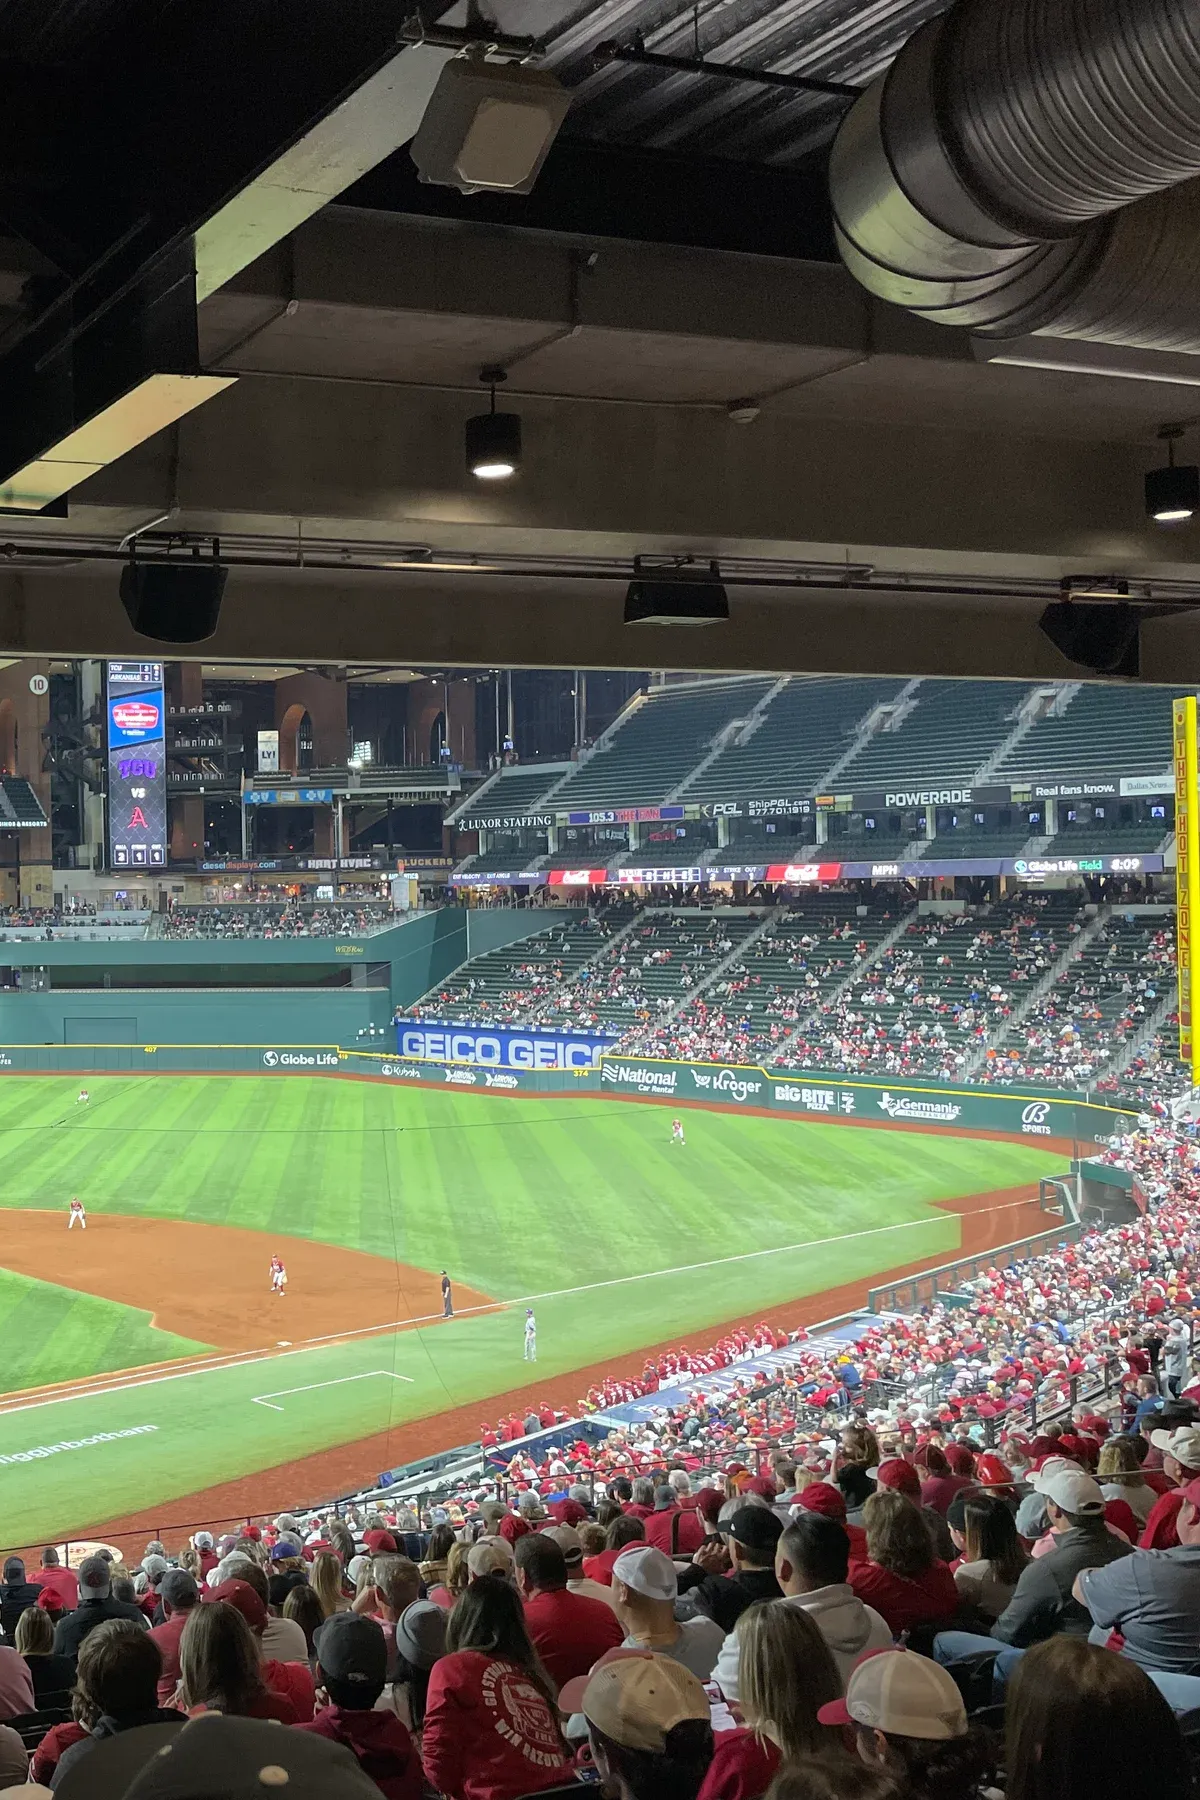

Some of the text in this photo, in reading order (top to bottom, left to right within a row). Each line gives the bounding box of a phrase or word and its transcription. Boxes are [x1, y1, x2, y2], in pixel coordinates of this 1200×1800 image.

[33, 679, 45, 690] 10
[118, 759, 157, 779] TCU
[131, 787, 146, 798] VS
[1035, 783, 1116, 797] Real fans know.
[713, 803, 743, 815] PGL
[748, 799, 810, 809] ShipPGL.com
[748, 806, 810, 816] 877.701.1919
[127, 806, 149, 829] A
[589, 808, 661, 823] 105.3 THE FAN
[468, 815, 552, 830] LUXOR STAFFING
[202, 860, 277, 871] dieseldisplays.com
[308, 858, 372, 869] HART HVAC
[1028, 859, 1140, 872] Globe Life Field 8:09
[872, 865, 898, 876] MPH
[402, 1031, 500, 1066] GEICO
[280, 1053, 339, 1065] Globe Life
[394, 1066, 421, 1078] Kubota
[573, 1069, 589, 1078] 374
[638, 1084, 675, 1094] Car Rental
[713, 1069, 762, 1102] Kroger
[801, 1088, 834, 1105] BITE
[807, 1102, 829, 1111] PIZZA
[900, 1098, 960, 1115] Germania
[1021, 1101, 1051, 1123] B
[904, 1110, 949, 1119] INSURANCE
[1022, 1124, 1051, 1135] SPORTS
[482, 1690, 498, 1706] GO
[494, 1718, 523, 1748] WIN
